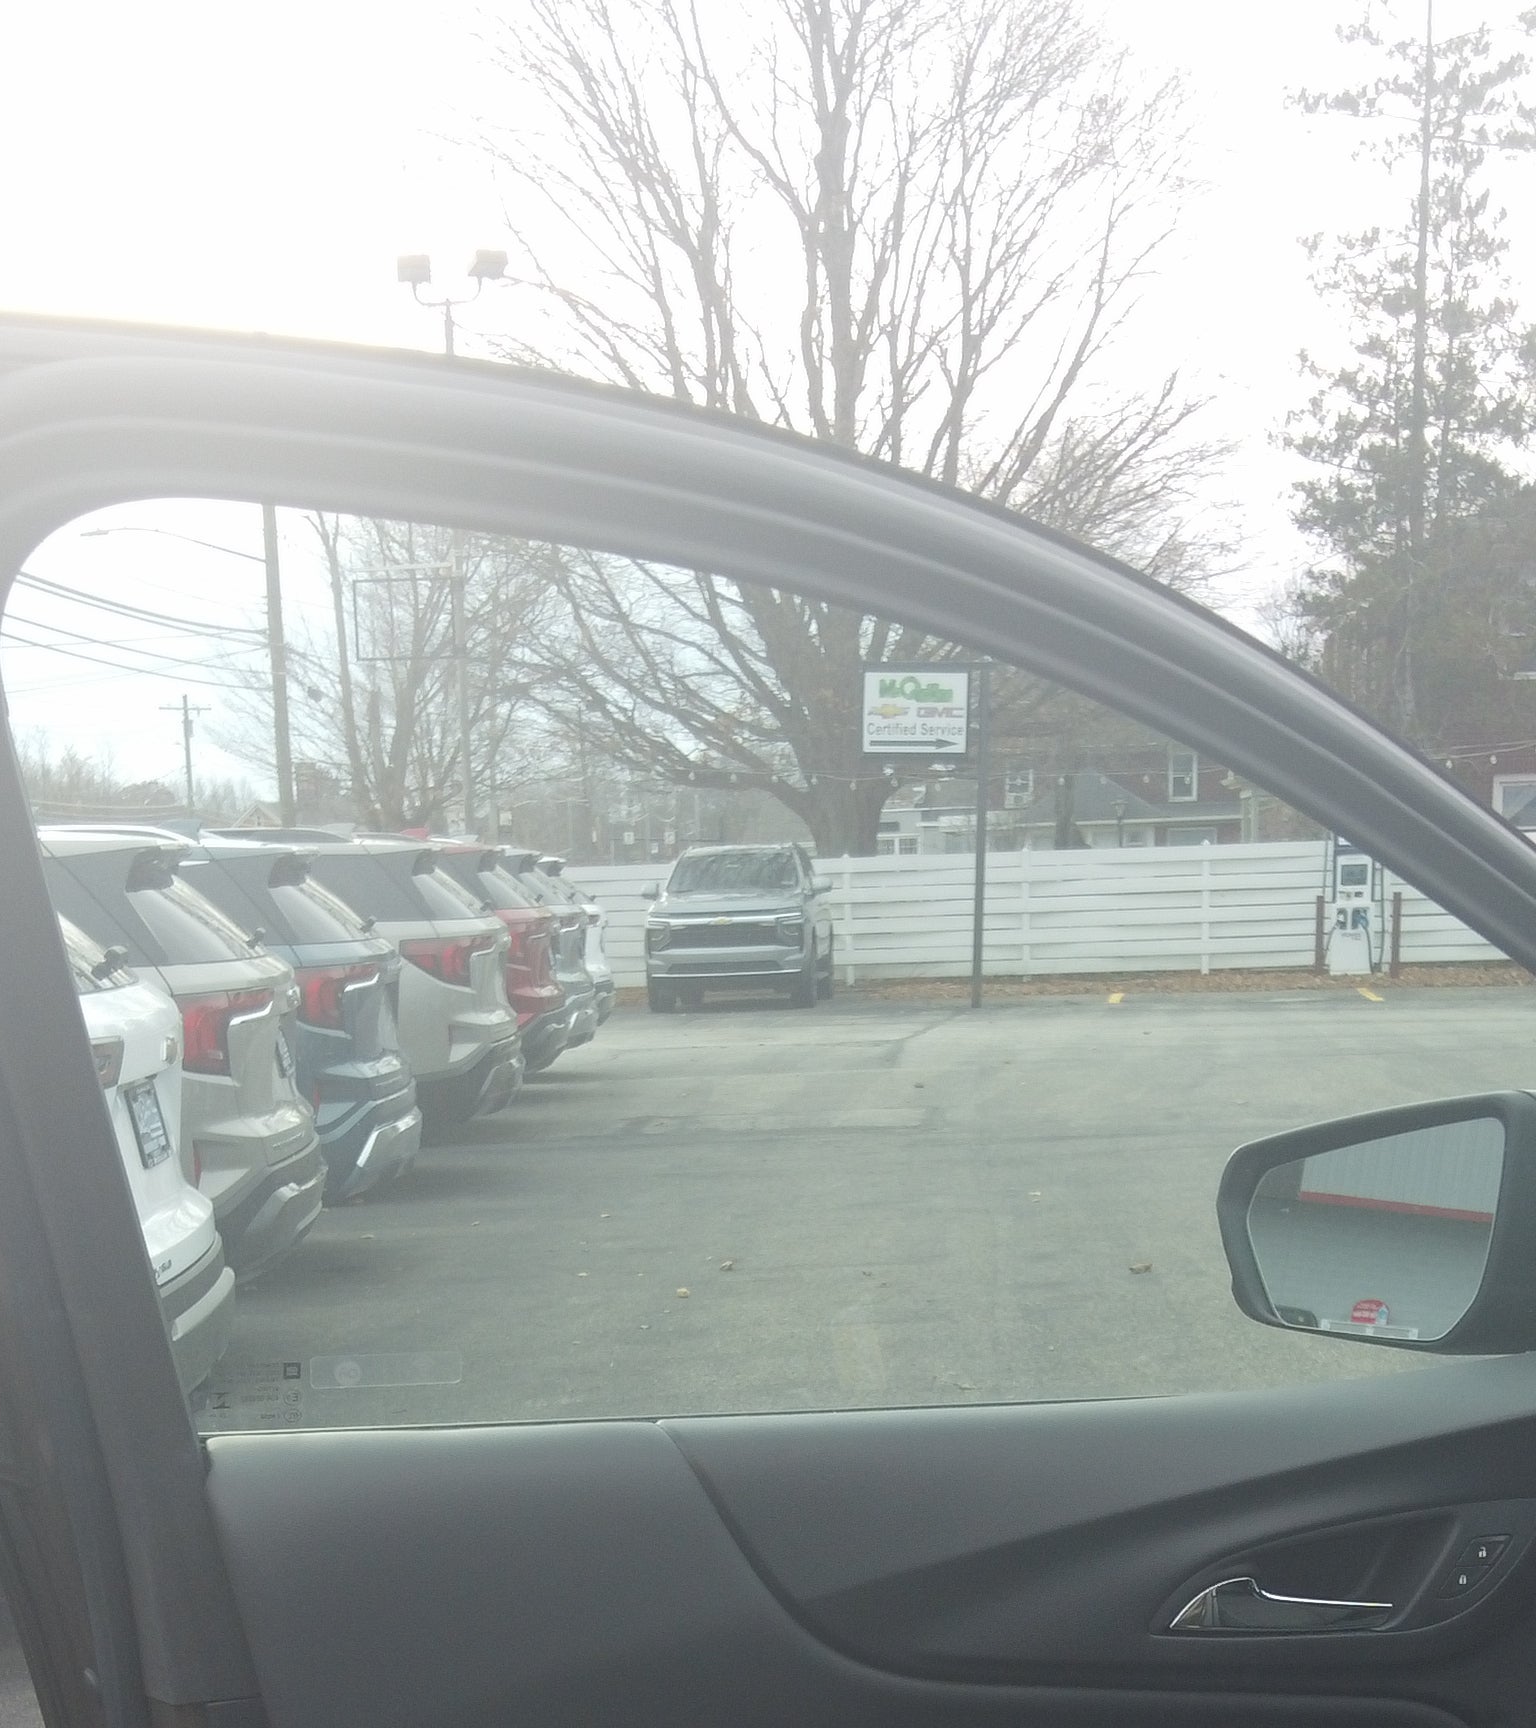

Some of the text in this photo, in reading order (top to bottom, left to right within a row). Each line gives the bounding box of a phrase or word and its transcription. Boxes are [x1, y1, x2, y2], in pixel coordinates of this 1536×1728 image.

[916, 706, 965, 718] GMC
[867, 722, 964, 736] Certified Service
